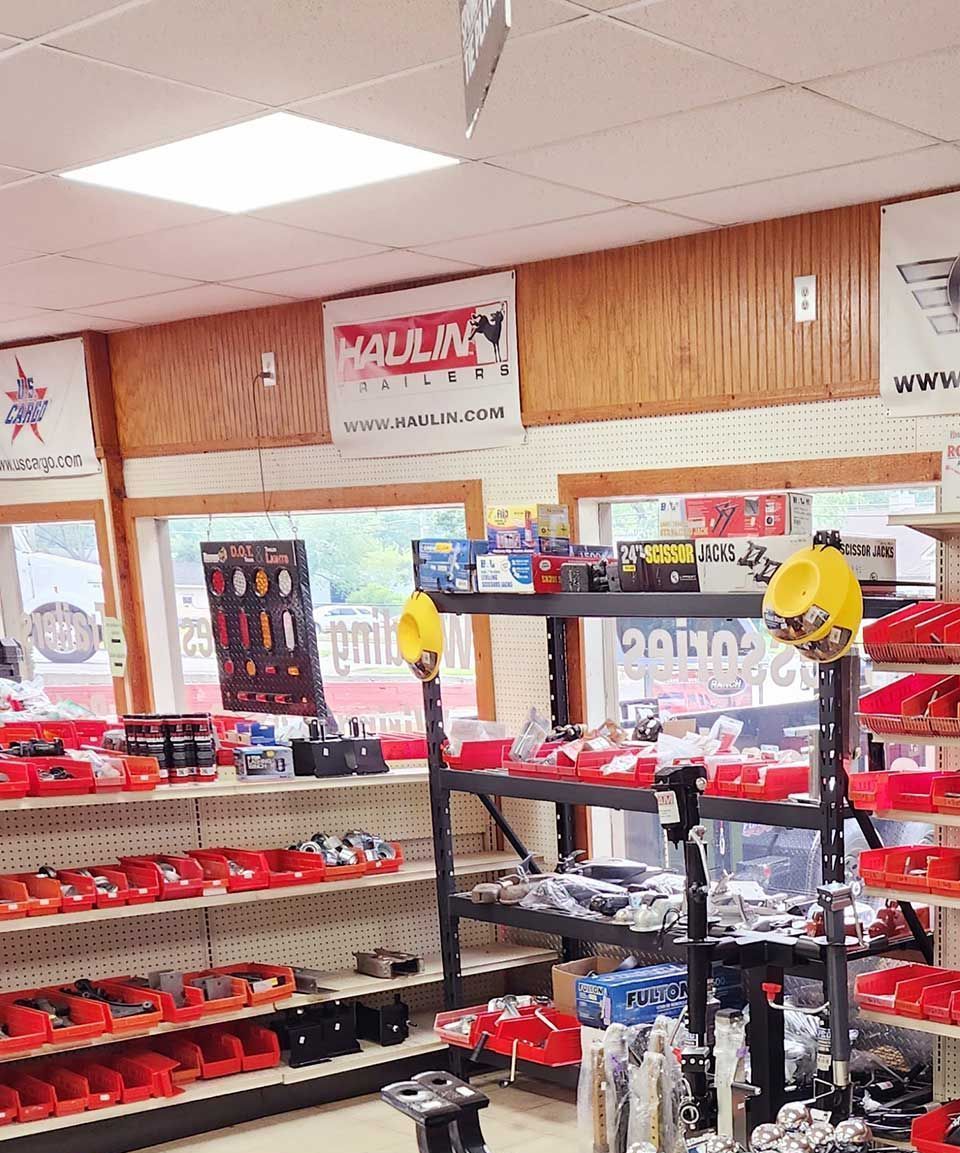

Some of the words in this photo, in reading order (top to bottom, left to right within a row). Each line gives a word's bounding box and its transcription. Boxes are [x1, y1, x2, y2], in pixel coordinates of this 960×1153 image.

[337, 322, 475, 370] HAULIN
[4, 400, 49, 424] CARGO
[344, 406, 505, 433] WWW.HAULIN.COM
[645, 543, 696, 564] SCISSOR
[698, 543, 736, 563] JACKS
[840, 543, 872, 558] SCISSOR
[873, 545, 895, 559] JACKS
[711, 680, 742, 690] RANCH
